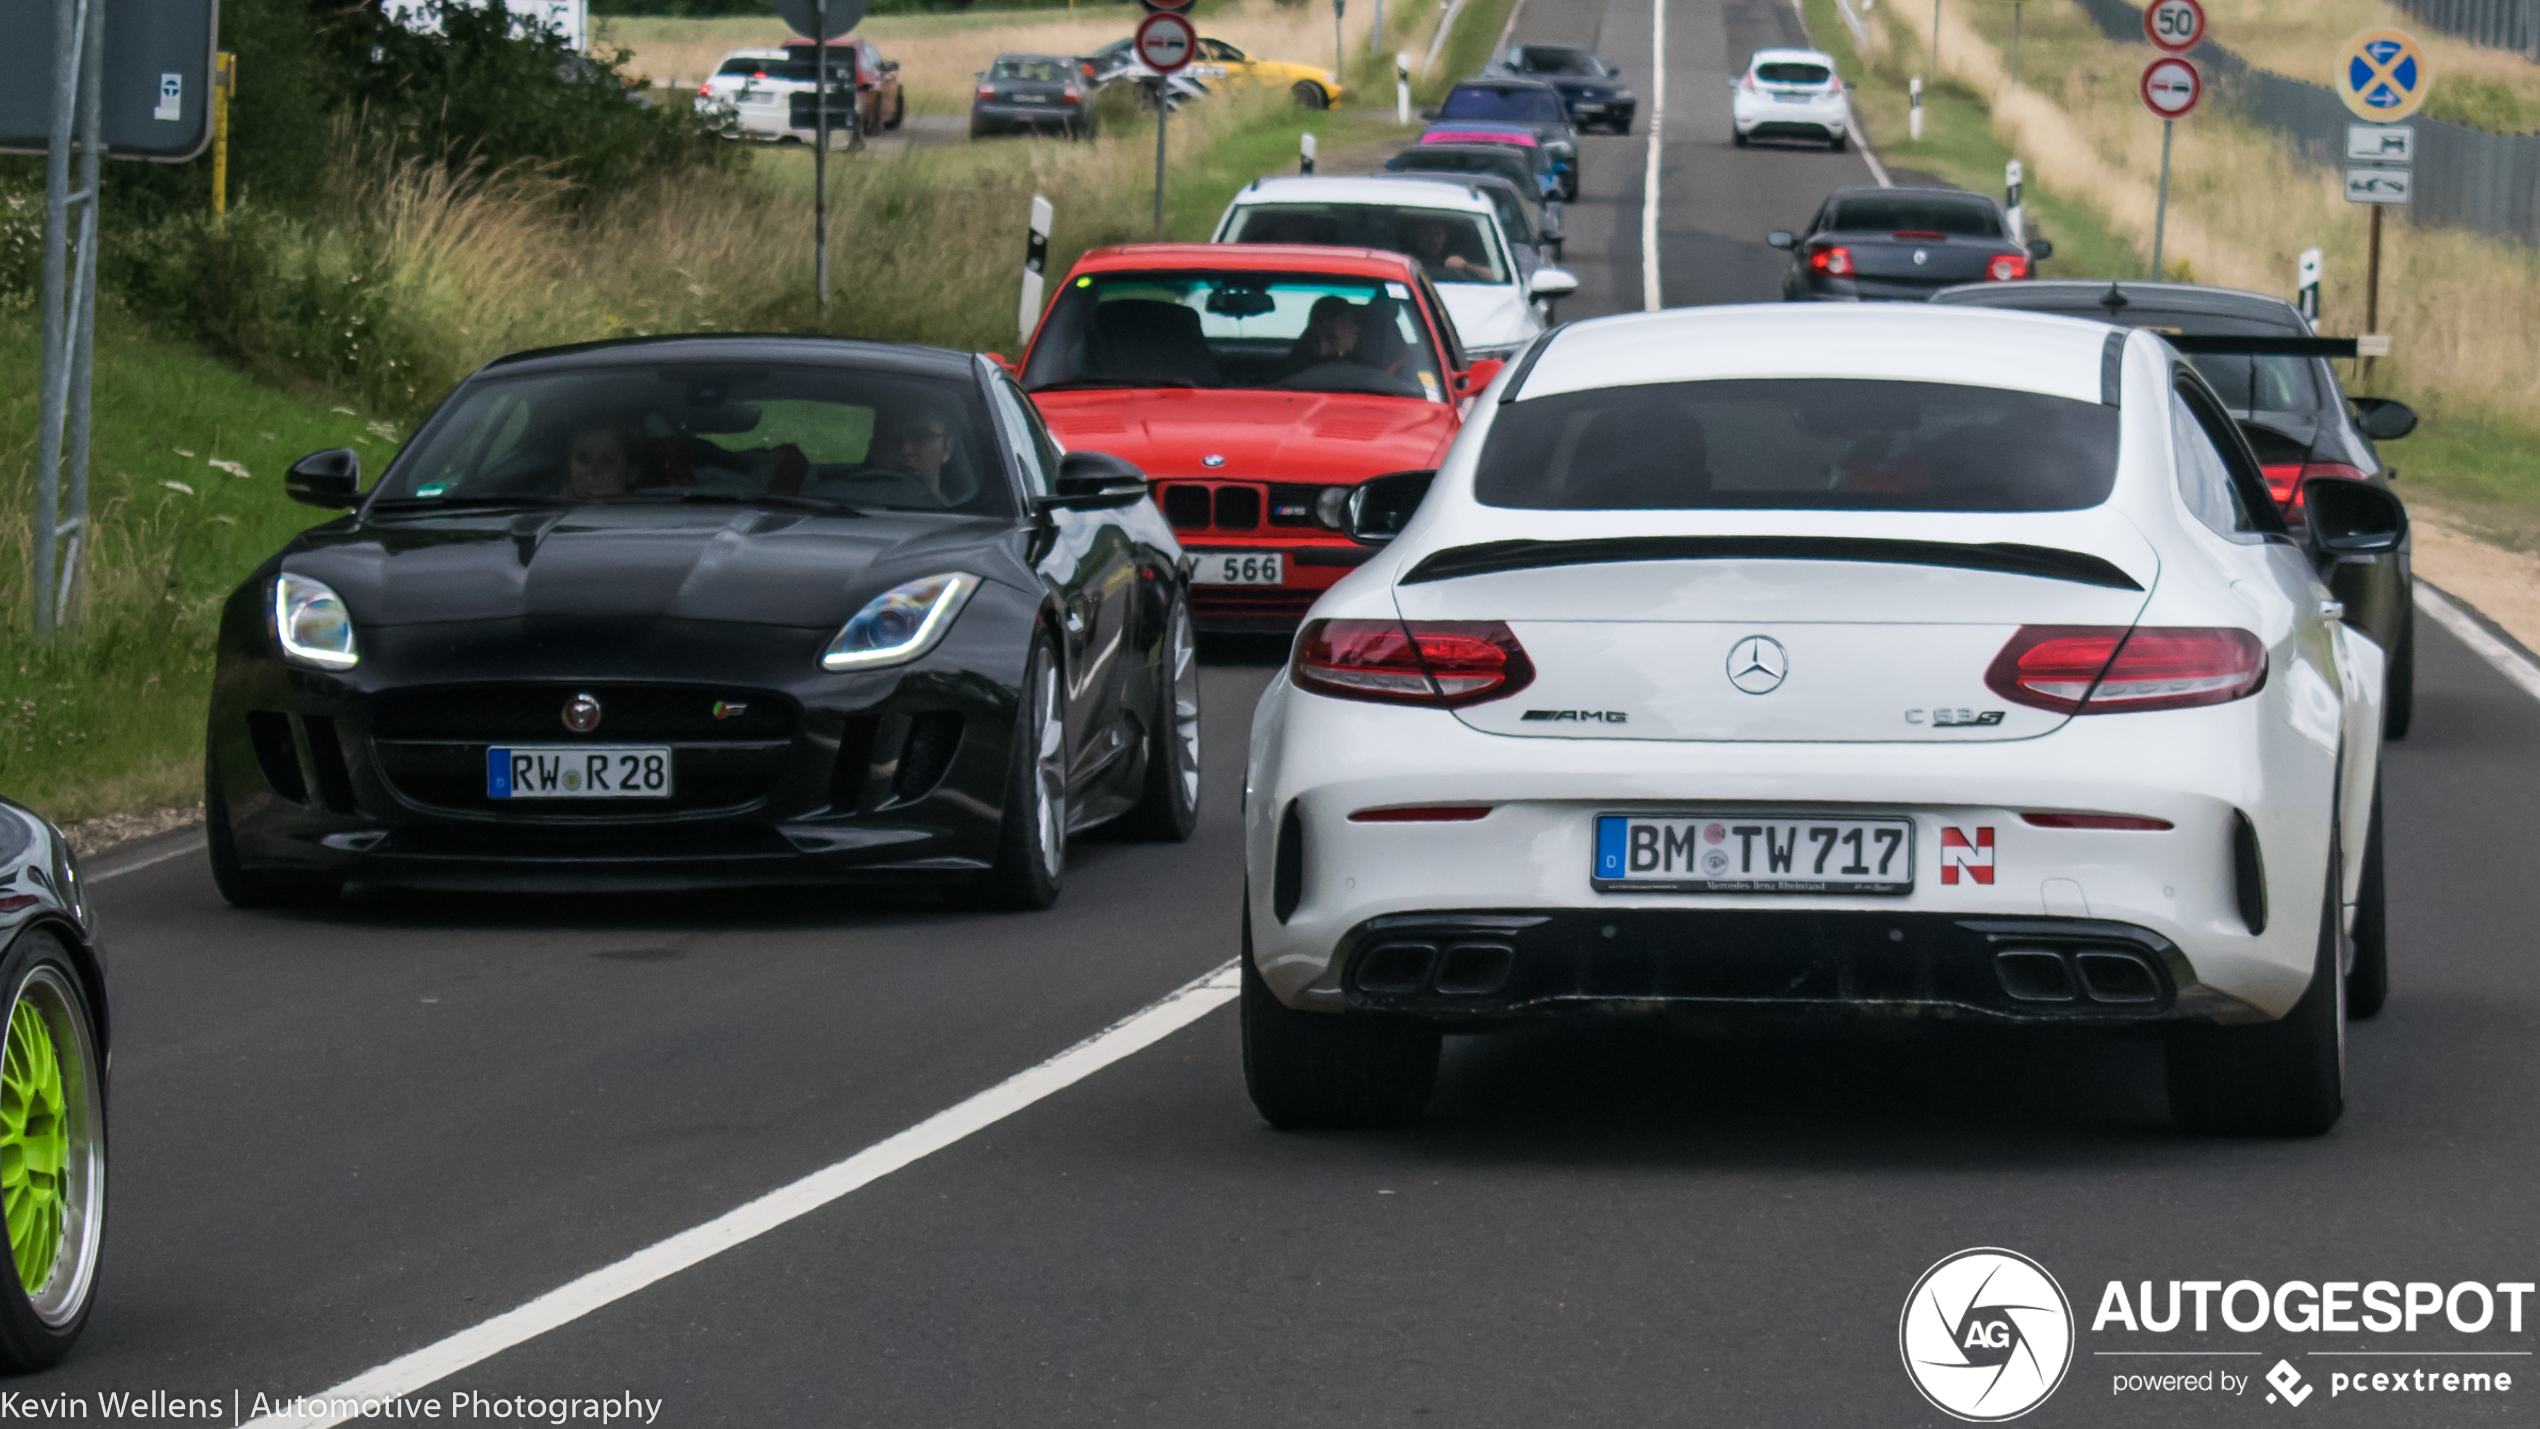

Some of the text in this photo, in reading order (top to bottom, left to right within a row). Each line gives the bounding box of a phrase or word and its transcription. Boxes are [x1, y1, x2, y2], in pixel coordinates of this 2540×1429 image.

[2160, 8, 2193, 36] 50
[1223, 557, 1277, 582] 566
[1555, 709, 1628, 724] AMG
[511, 755, 665, 791] RW R 28
[1629, 824, 1903, 875] BM TW 717
